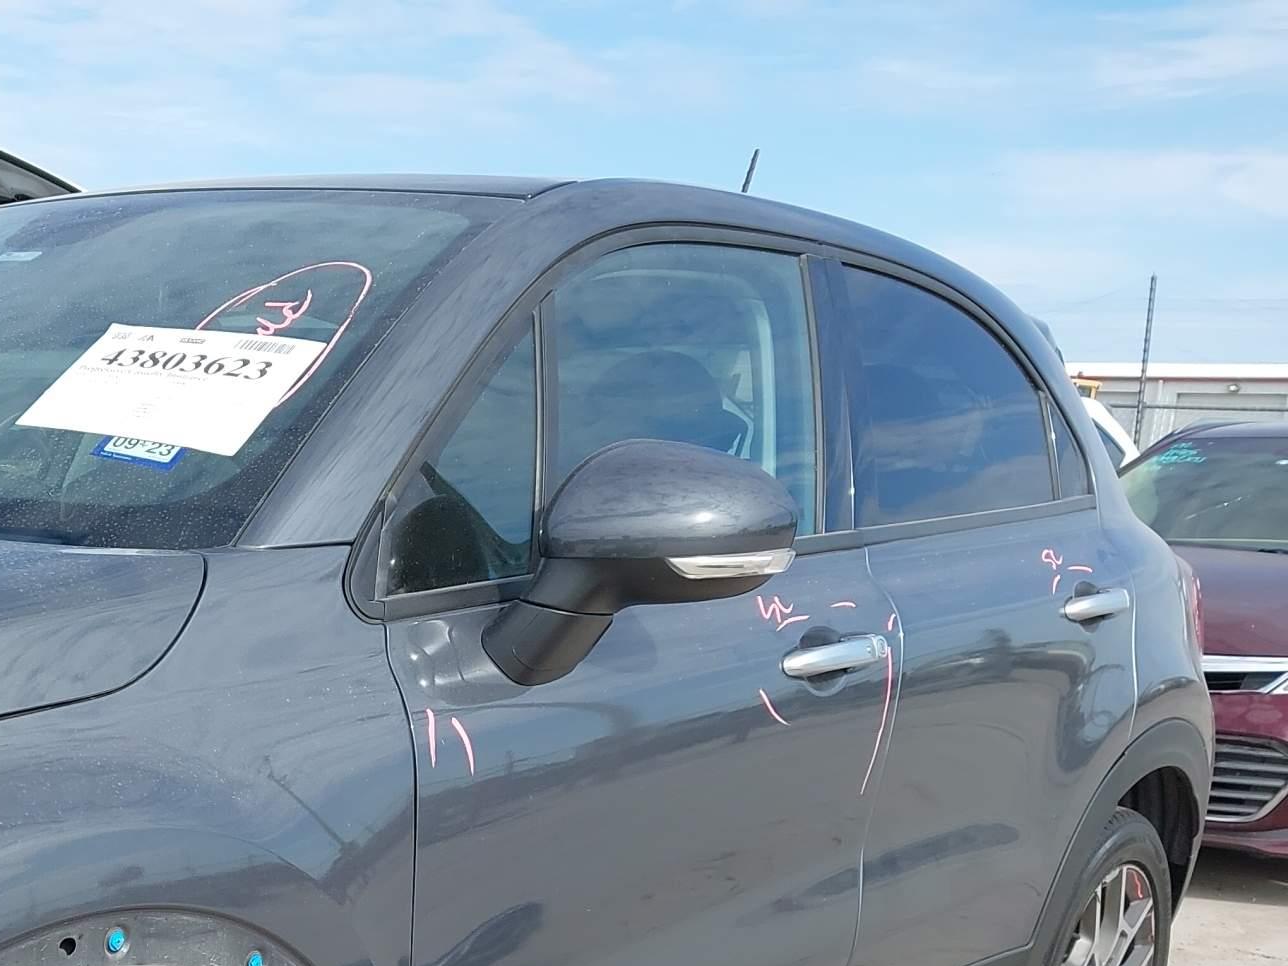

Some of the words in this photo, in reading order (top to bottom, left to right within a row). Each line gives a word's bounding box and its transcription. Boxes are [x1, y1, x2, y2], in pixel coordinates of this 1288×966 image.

[102, 348, 273, 380] 43803623
[112, 436, 140, 450] 09
[146, 441, 175, 457] 23
